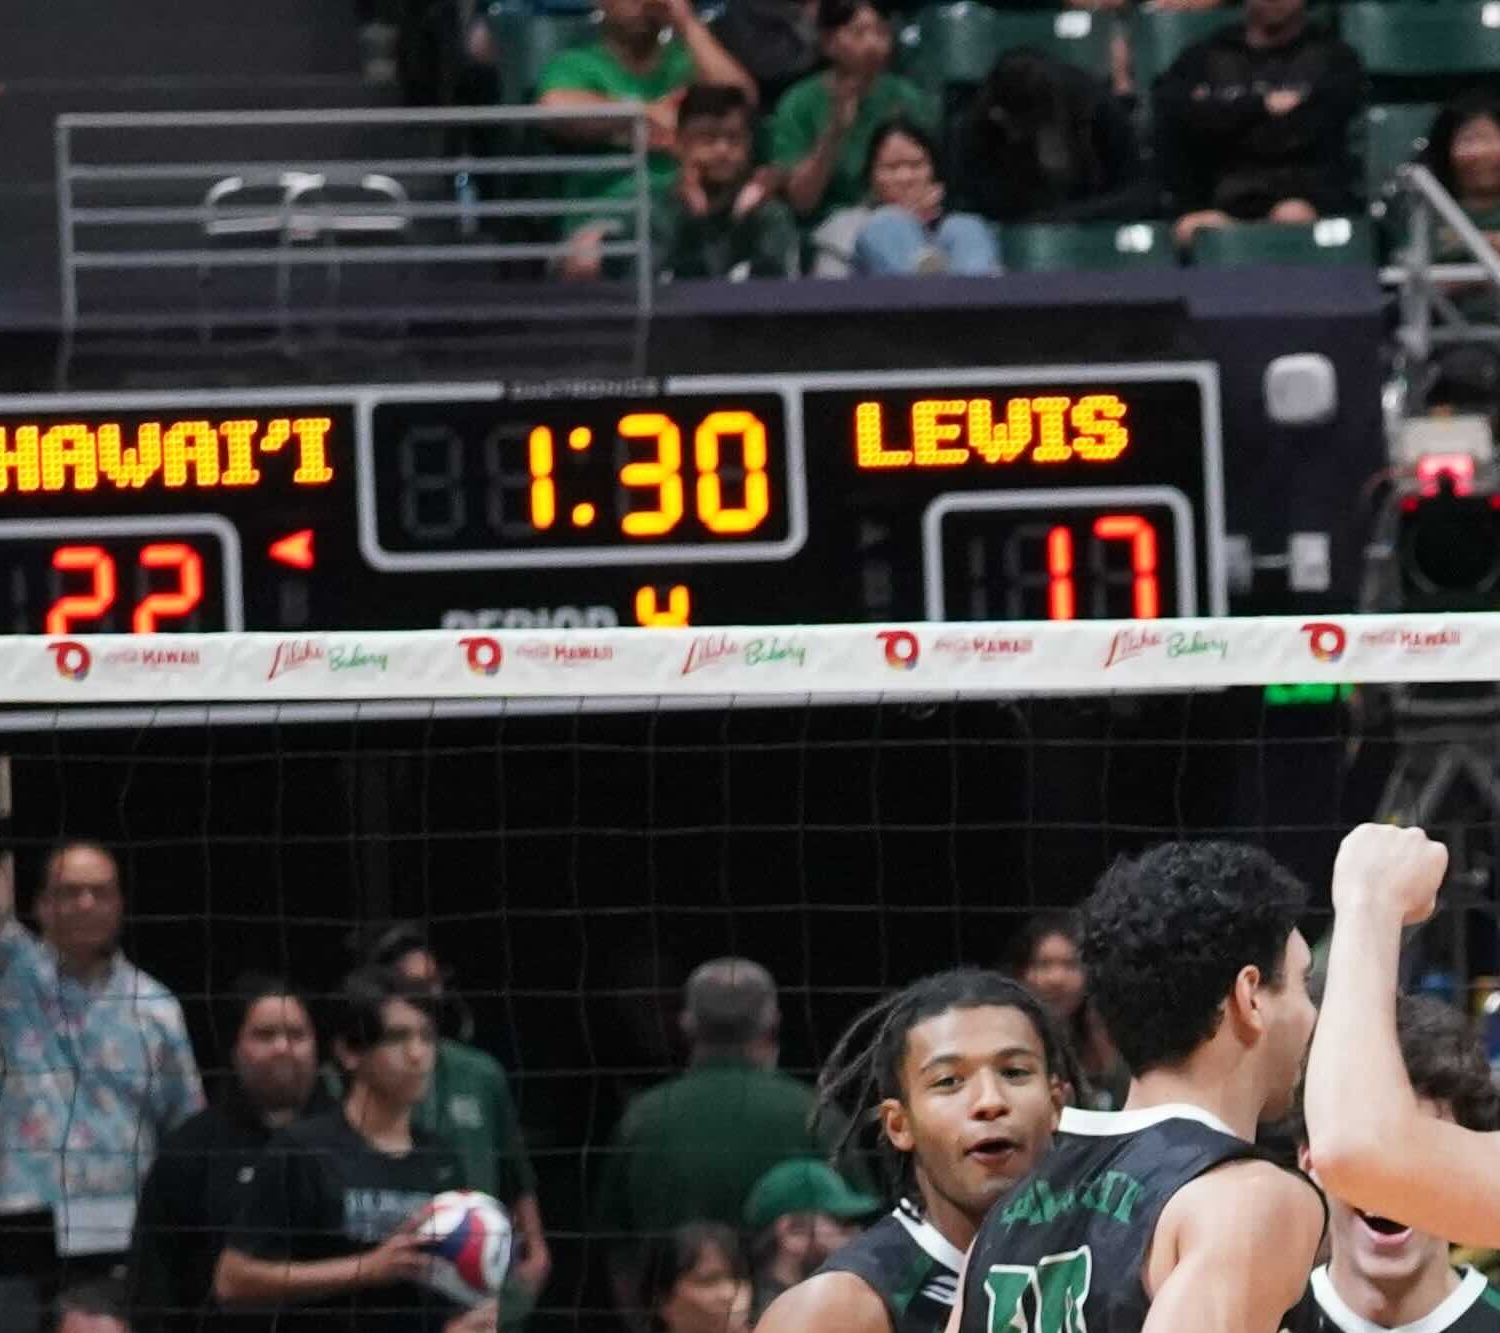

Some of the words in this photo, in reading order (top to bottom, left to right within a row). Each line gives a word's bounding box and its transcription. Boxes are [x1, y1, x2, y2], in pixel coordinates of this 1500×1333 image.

[528, 409, 770, 537] 1:30
[855, 394, 1129, 468] LEWIS
[45, 542, 203, 635] 22
[1046, 514, 1159, 620] 17
